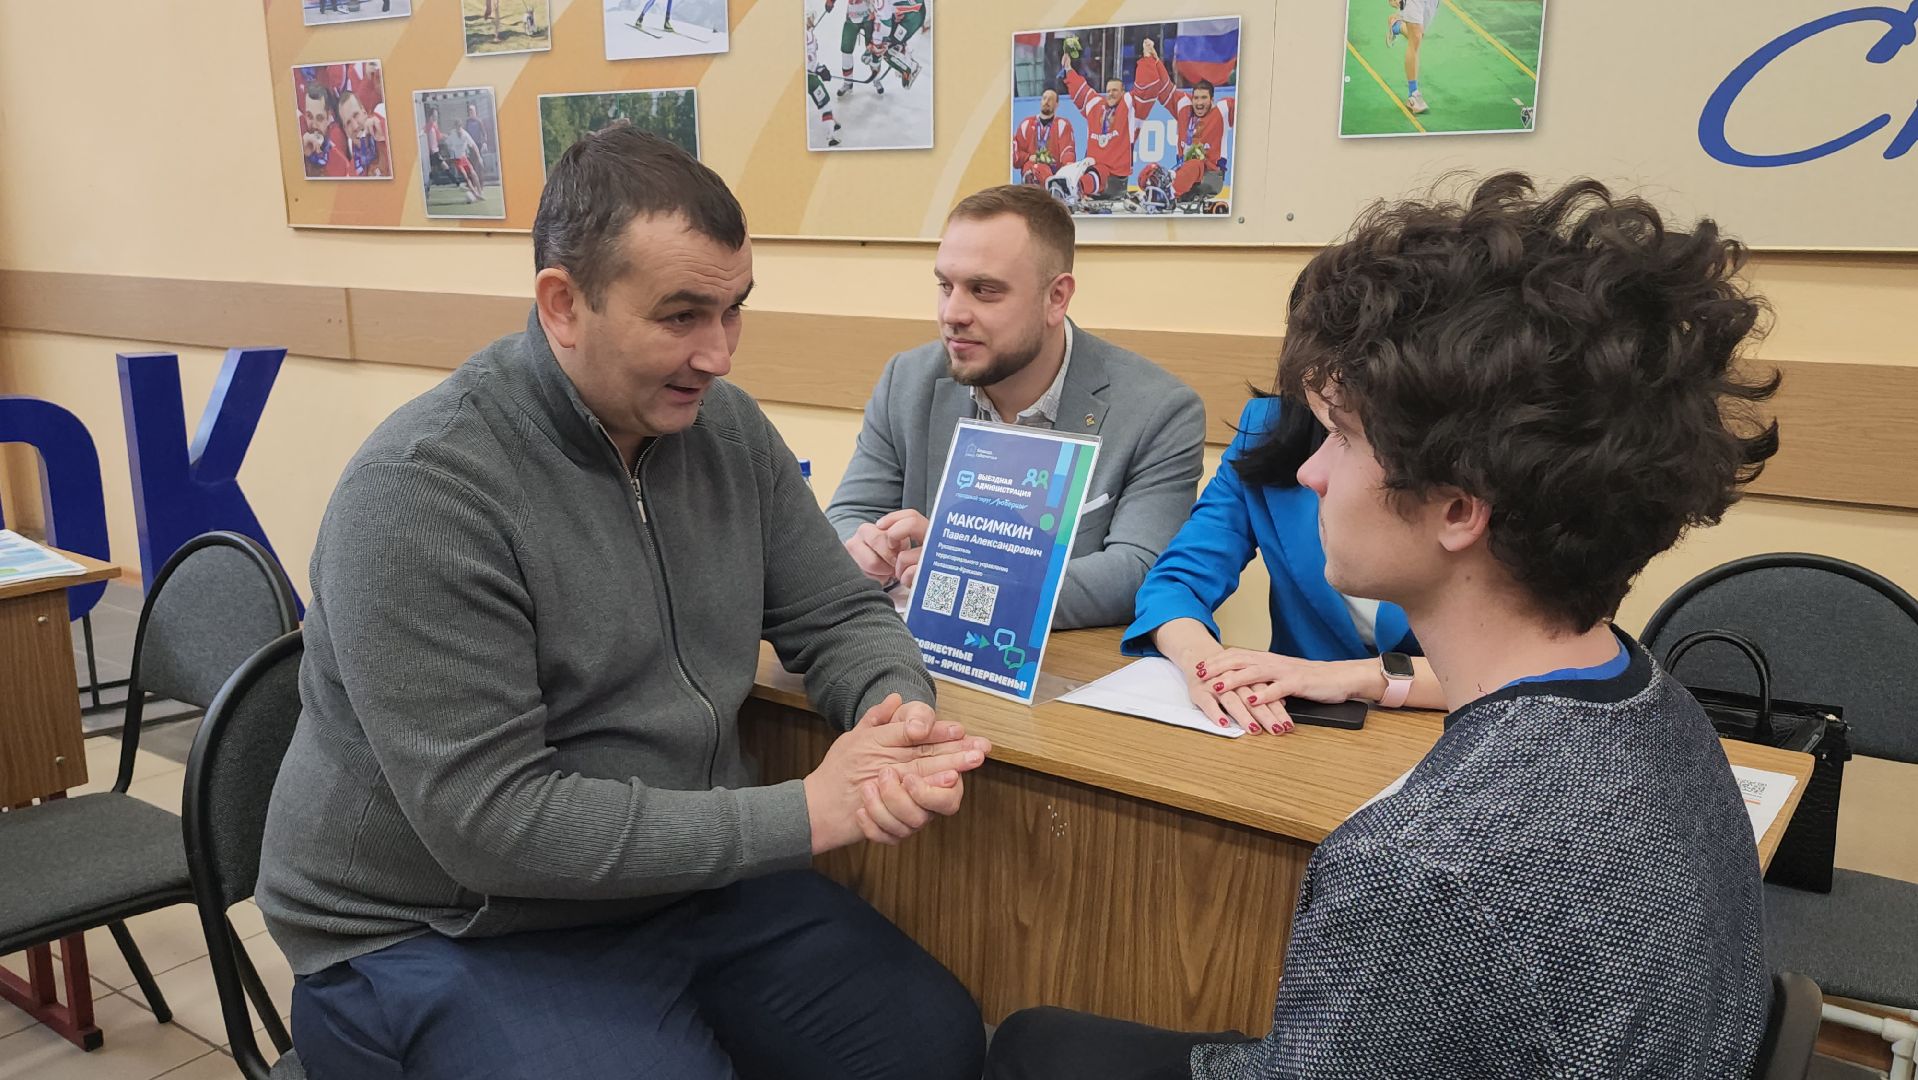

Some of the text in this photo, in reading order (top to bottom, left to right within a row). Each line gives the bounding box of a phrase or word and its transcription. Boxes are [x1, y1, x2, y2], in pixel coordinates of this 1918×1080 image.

[977, 473, 1013, 486] ВЫЕЗДНАЯ
[974, 481, 1032, 498] АДМИНИСТРАЦИЯ
[947, 512, 1033, 540] МАКСИМКИН
[942, 527, 1043, 558] Павел Александрович
[940, 658, 971, 675] ЯРКИЕ
